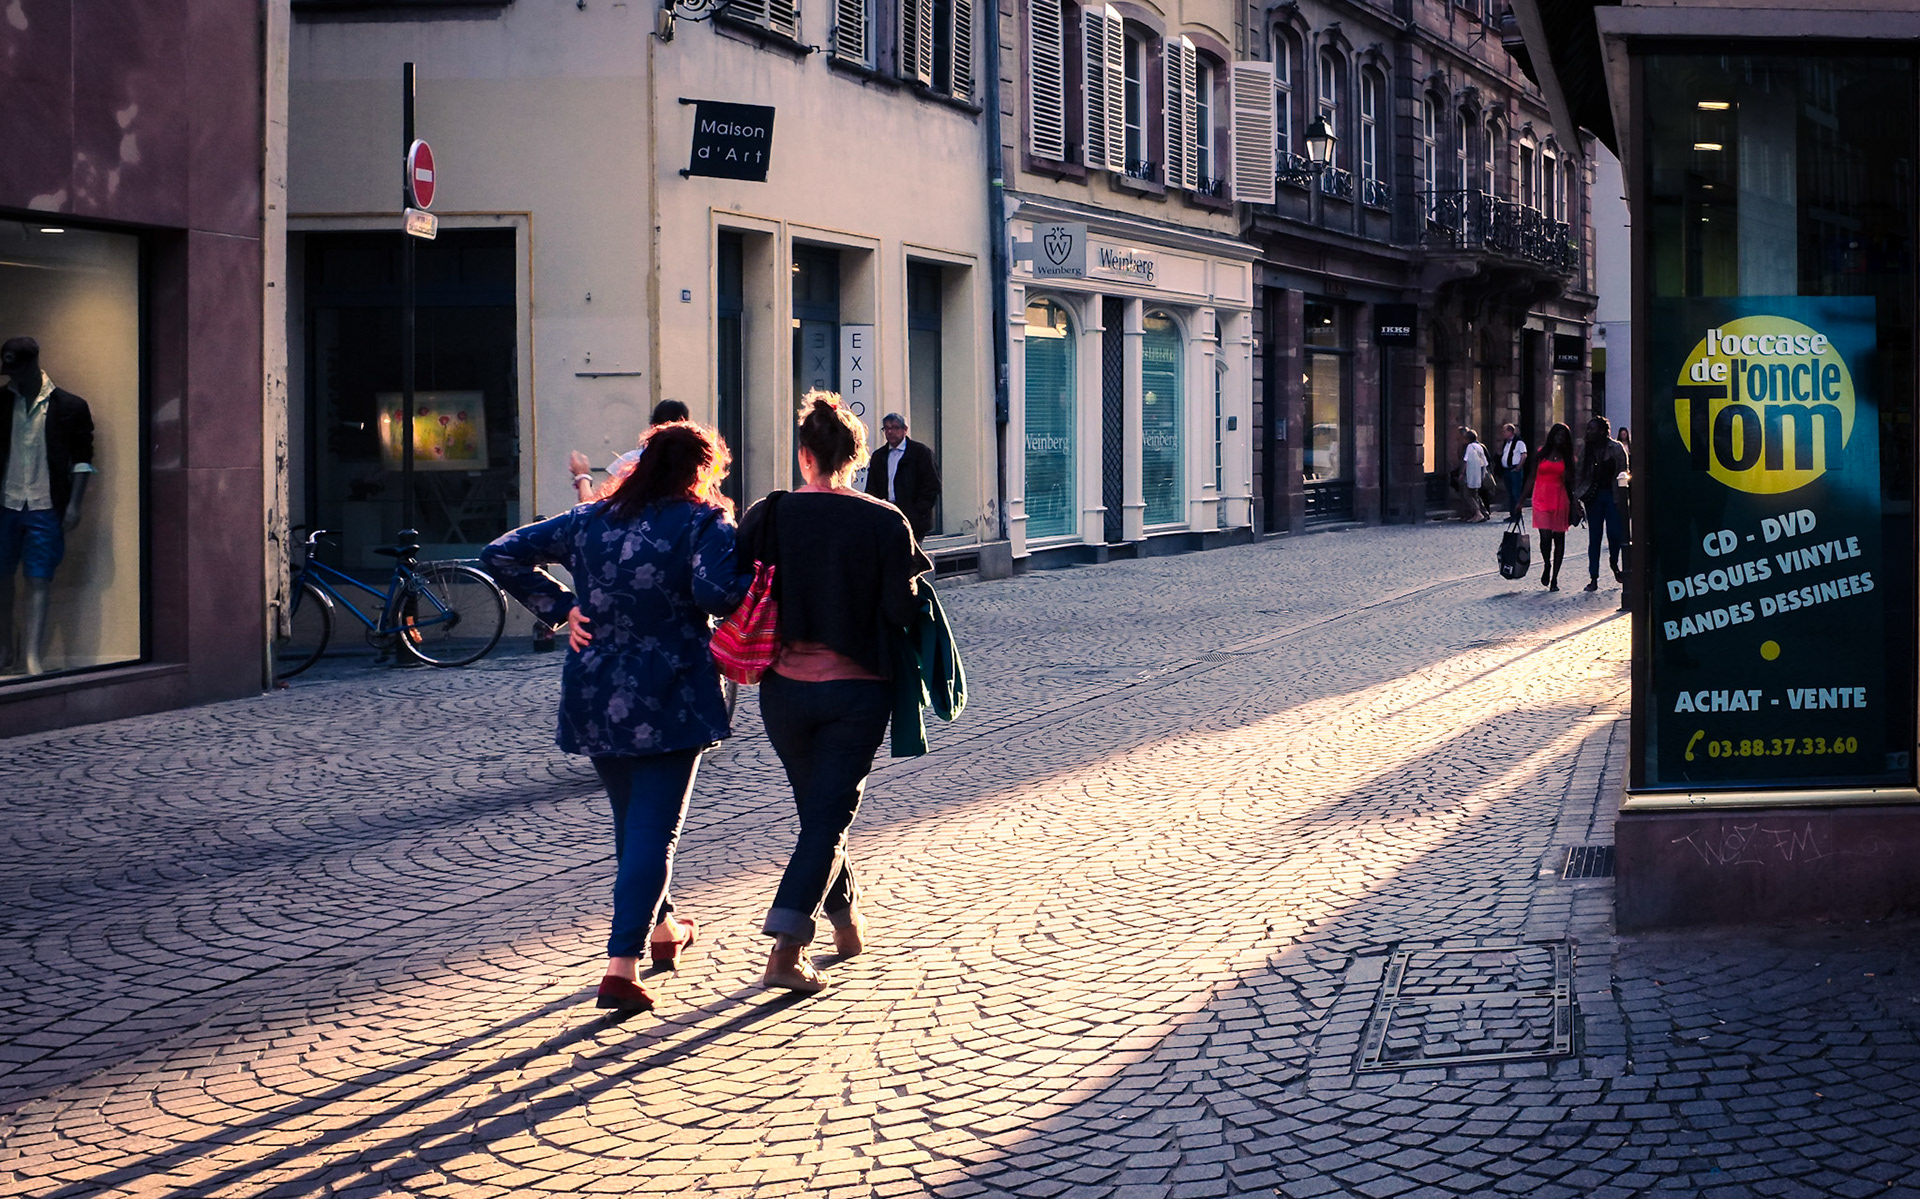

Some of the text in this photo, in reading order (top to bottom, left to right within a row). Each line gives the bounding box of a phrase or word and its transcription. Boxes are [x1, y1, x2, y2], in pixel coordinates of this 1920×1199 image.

[701, 119, 765, 139] Maison
[1049, 241, 1067, 256] W
[1100, 247, 1154, 282] Weinberg
[1038, 266, 1082, 276] Weinberg
[1706, 328, 1828, 357] l'occase
[850, 333, 866, 418] EXPO
[1689, 357, 1842, 402] de l'oncle
[1674, 384, 1844, 473] Tom
[1702, 528, 1738, 557] CD
[1760, 508, 1817, 543] DVD
[1666, 535, 1862, 602] DISQUES VINYLE
[1663, 571, 1875, 641] BANDES DESSINEES
[1674, 690, 1762, 713] ACHAT
[1786, 687, 1867, 710] VENTE
[1708, 736, 1858, 758] 03.88.37.33.60
